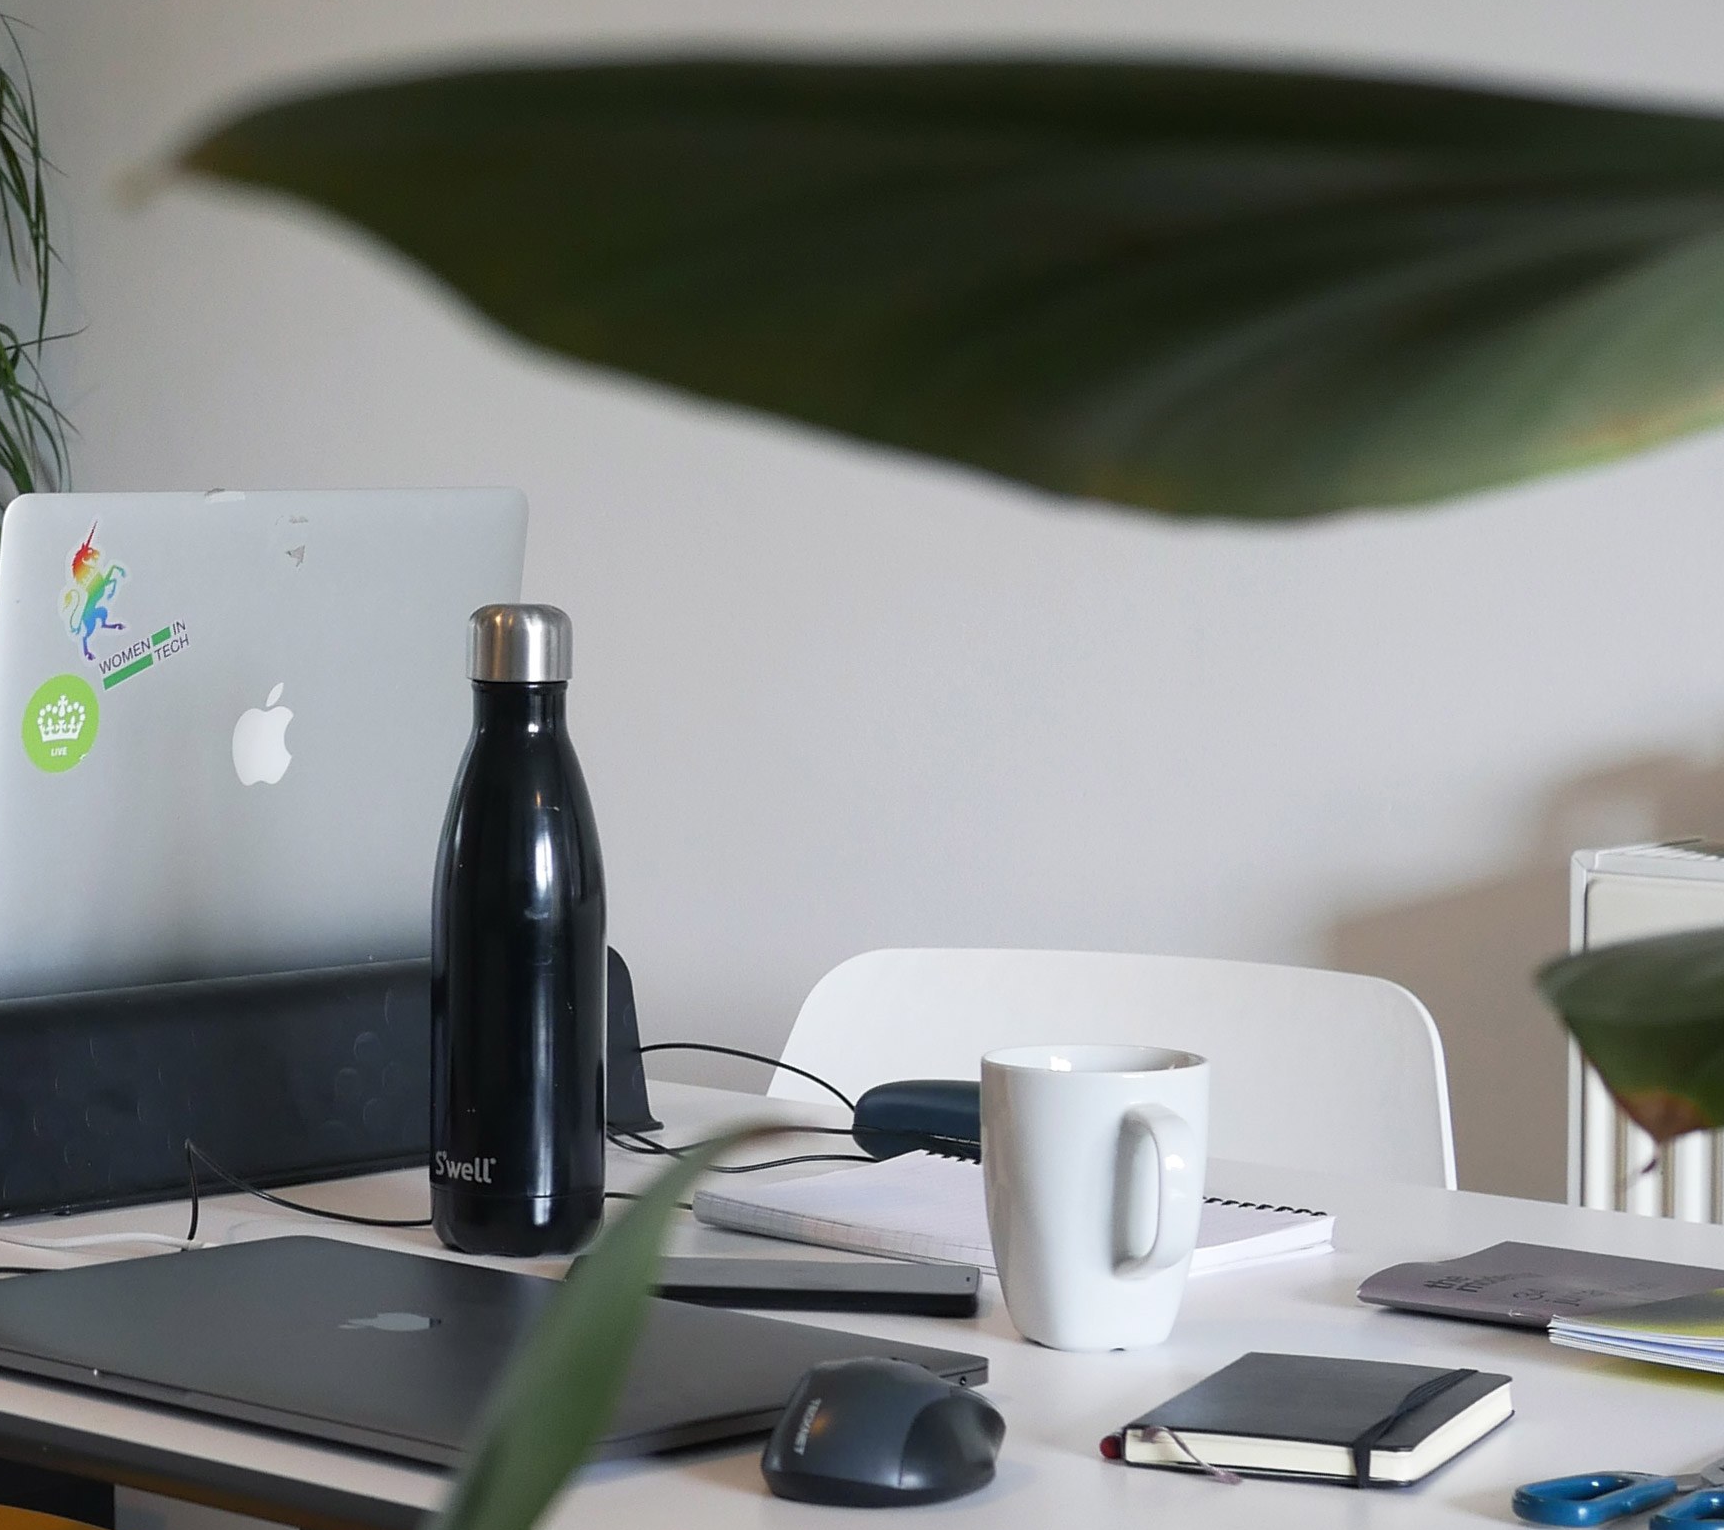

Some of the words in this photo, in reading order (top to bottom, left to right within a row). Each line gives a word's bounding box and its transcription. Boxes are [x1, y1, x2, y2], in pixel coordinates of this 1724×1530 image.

[99, 638, 151, 674] WOMEN
[172, 620, 186, 635] IN
[154, 634, 189, 661] TECH
[51, 747, 67, 756] LIVE
